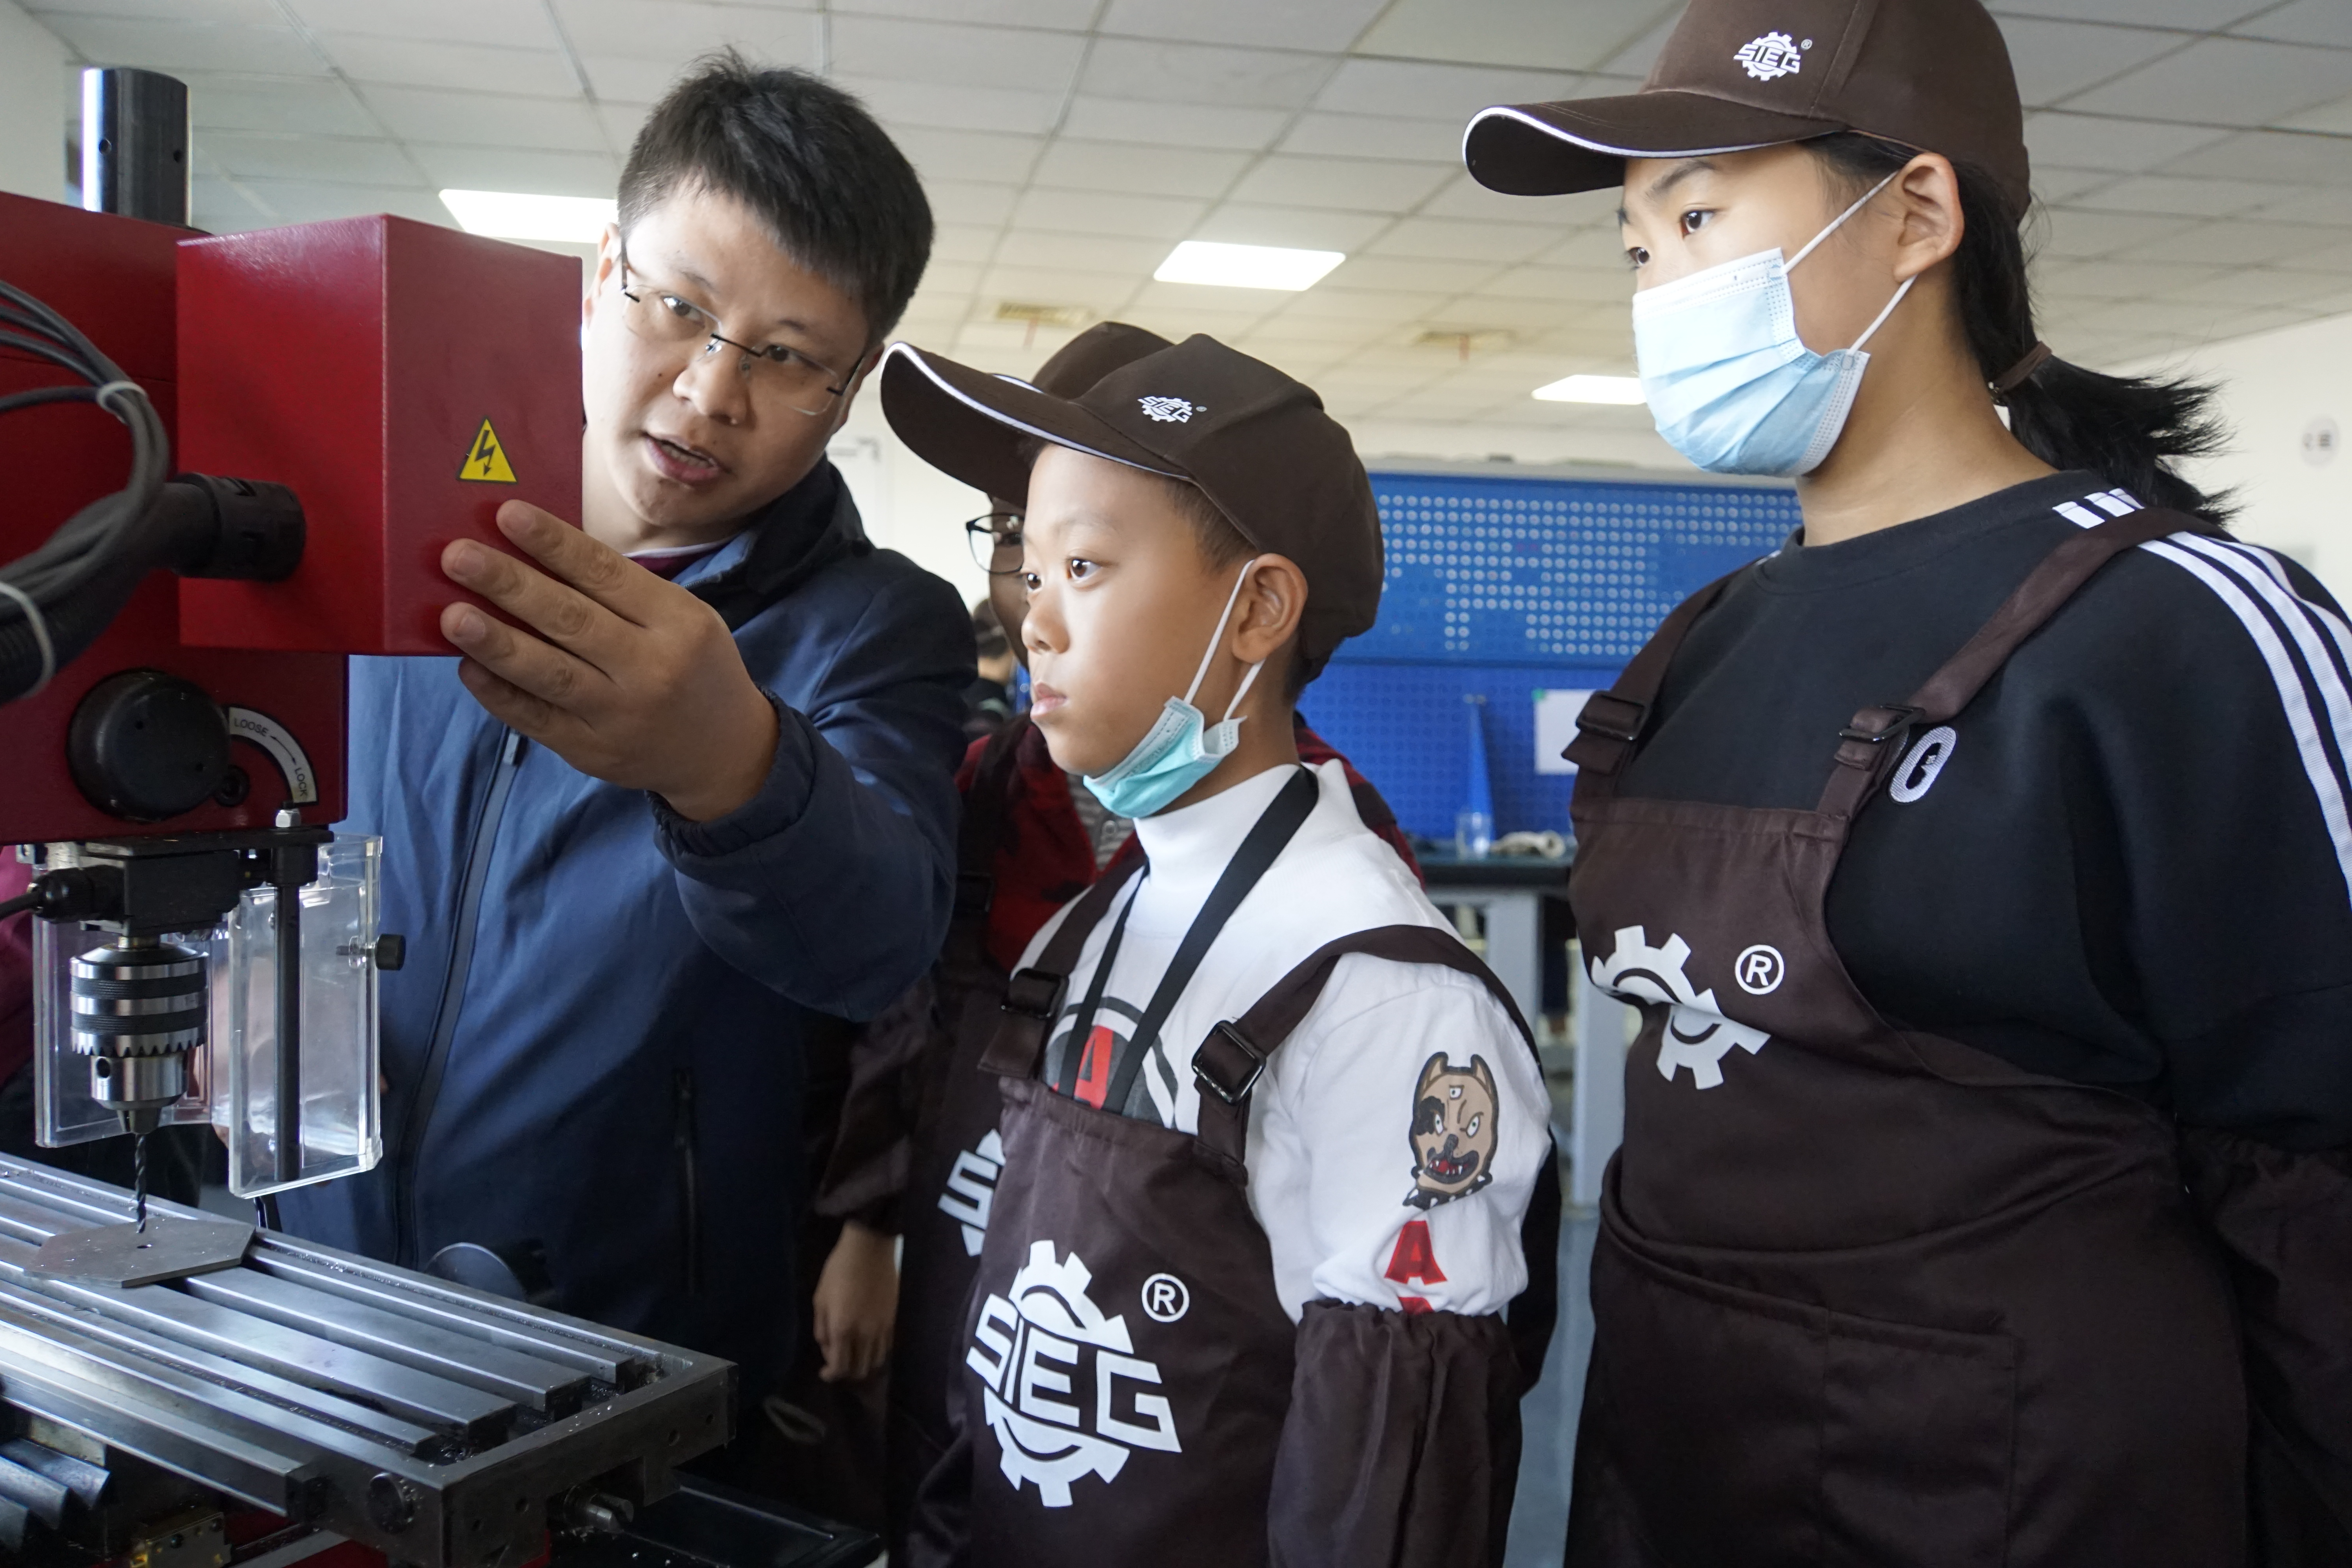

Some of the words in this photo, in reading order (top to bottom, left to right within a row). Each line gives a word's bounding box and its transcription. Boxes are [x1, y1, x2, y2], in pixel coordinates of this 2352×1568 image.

[1733, 44, 1801, 74] SIEG
[1137, 396, 1193, 423] SIEG
[234, 717, 269, 737] LOOSE
[294, 767, 308, 797] LOCK
[965, 1293, 1182, 1453] SIEG
